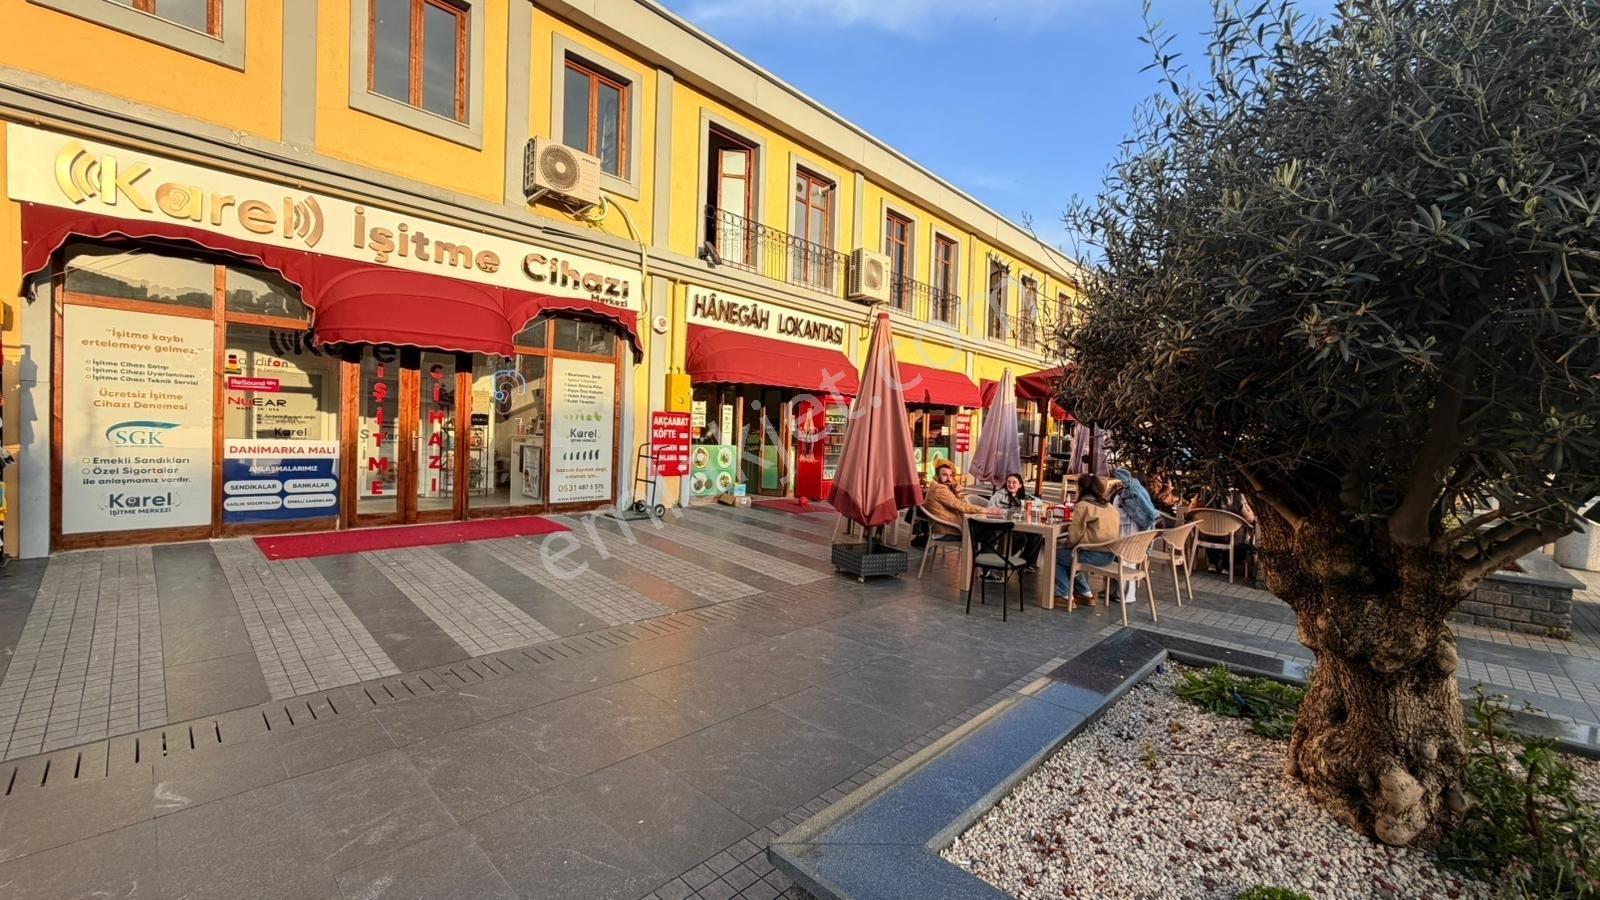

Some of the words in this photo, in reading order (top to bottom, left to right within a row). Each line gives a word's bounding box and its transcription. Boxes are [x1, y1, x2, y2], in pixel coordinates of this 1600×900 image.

[99, 154, 294, 239] Karel
[353, 205, 500, 273] İşitme
[520, 253, 629, 299] Cihazı
[590, 293, 628, 308] Merkezi
[693, 293, 770, 330] HÂNEGÂH
[777, 313, 844, 345] LOKANTASI
[152, 333, 184, 344] kaybı
[81, 339, 151, 351] ertelemeye
[92, 358, 118, 367] İşitme
[92, 365, 118, 375] İşitme
[92, 373, 118, 382] İşitme
[99, 387, 147, 399] Ücretsiz
[149, 391, 183, 401] İşitme
[93, 399, 131, 409] Cihazı
[133, 401, 188, 411] Denemesi
[653, 416, 689, 428] AKÇAABAT
[274, 427, 307, 437] Karel
[368, 363, 389, 495] İŞİTME
[428, 364, 445, 492] CİHAZI
[569, 428, 597, 439] Karel
[653, 428, 677, 439] KÖFTE
[115, 430, 164, 445] SGK
[229, 445, 305, 454] DANİMARKA
[308, 446, 336, 454] MALI
[92, 456, 131, 465] Emekli
[134, 456, 190, 465] Sandıkları
[92, 465, 120, 476] Özel
[122, 466, 179, 476] Sigortalar
[248, 465, 318, 474] ANLAŞMALARIMIZ
[82, 477, 96, 485] ile
[98, 477, 158, 486] anlaşmamız
[160, 476, 192, 484] vardır.
[230, 482, 277, 491] SENDİKALAR
[558, 484, 577, 492] 0531
[109, 492, 172, 508] Karel
[109, 508, 136, 516] İŞİTME
